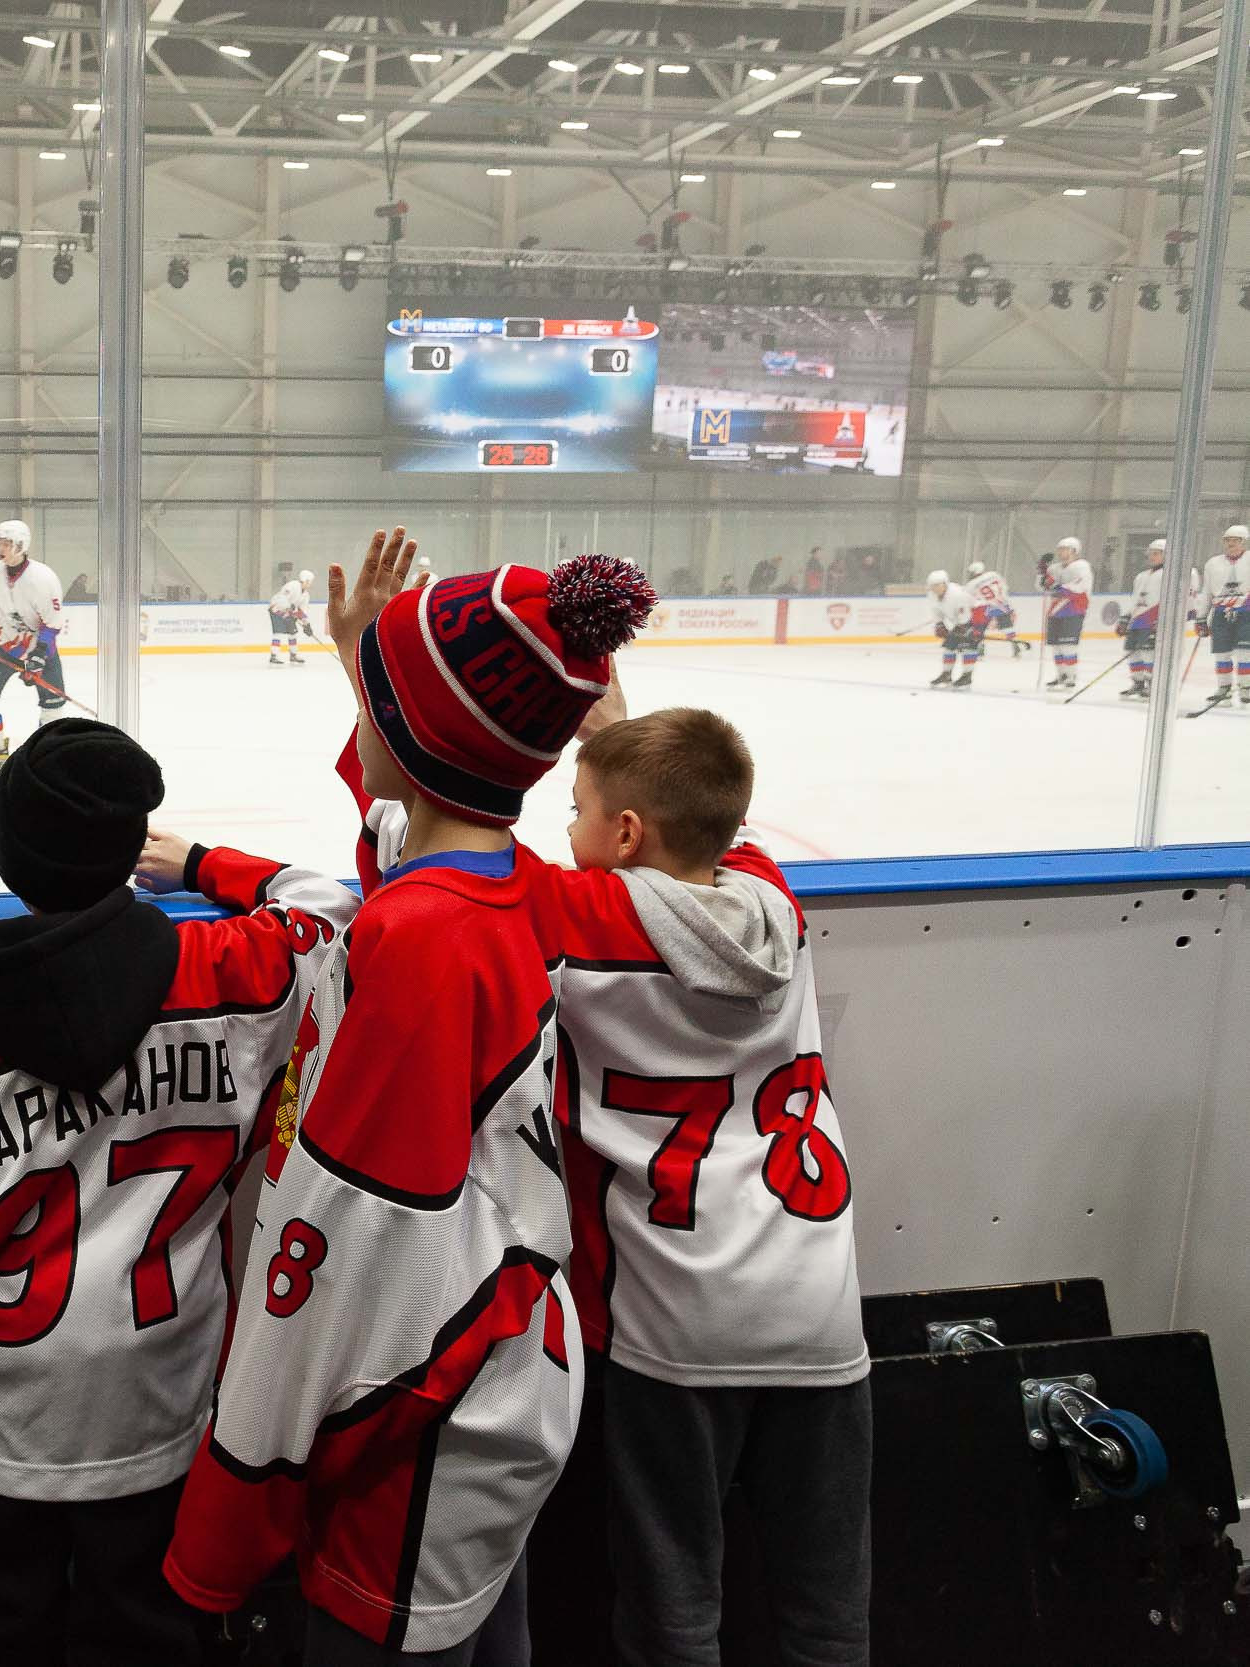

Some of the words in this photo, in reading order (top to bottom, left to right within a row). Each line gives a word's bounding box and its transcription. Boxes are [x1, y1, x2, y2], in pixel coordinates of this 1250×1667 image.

[431, 347, 446, 368] 0
[611, 351, 626, 371] 0
[600, 1052, 852, 1230] 78
[265, 1217, 328, 1318] 8
